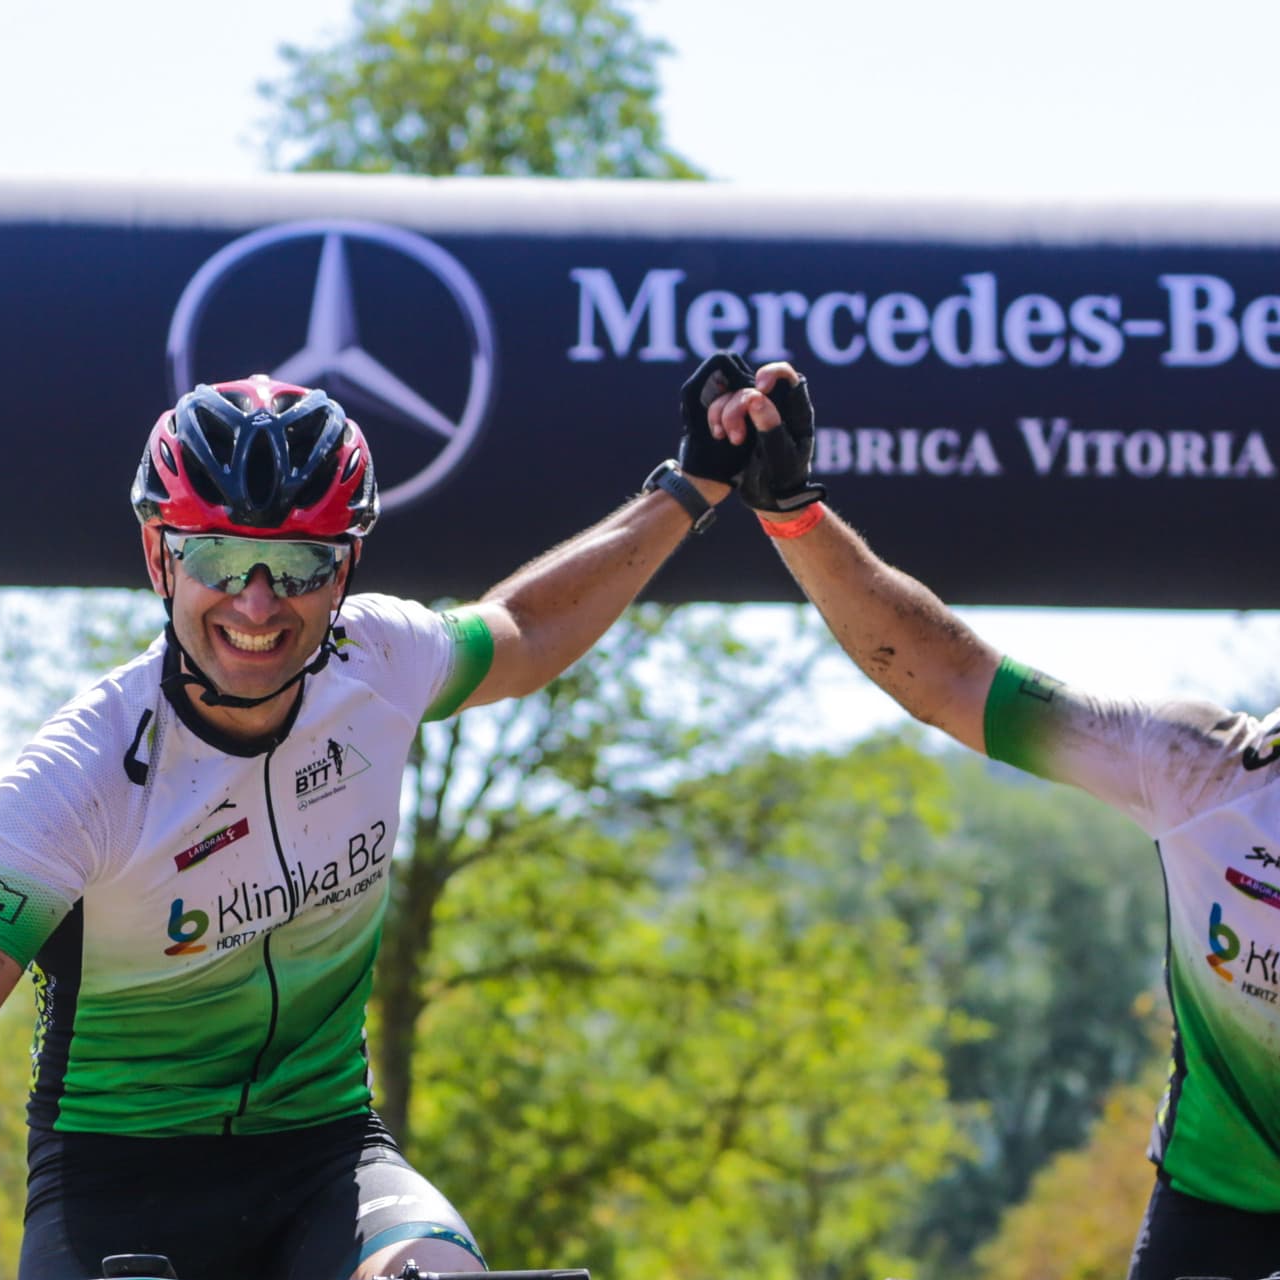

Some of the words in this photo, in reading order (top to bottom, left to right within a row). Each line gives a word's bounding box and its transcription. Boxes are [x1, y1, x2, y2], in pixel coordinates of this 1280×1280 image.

[816, 424, 1000, 477] BRICA
[1018, 418, 1277, 478] VITORIA
[295, 763, 332, 794] BTT
[188, 832, 227, 858] LABORAL
[217, 861, 339, 933] Klinika
[349, 820, 386, 878] B2
